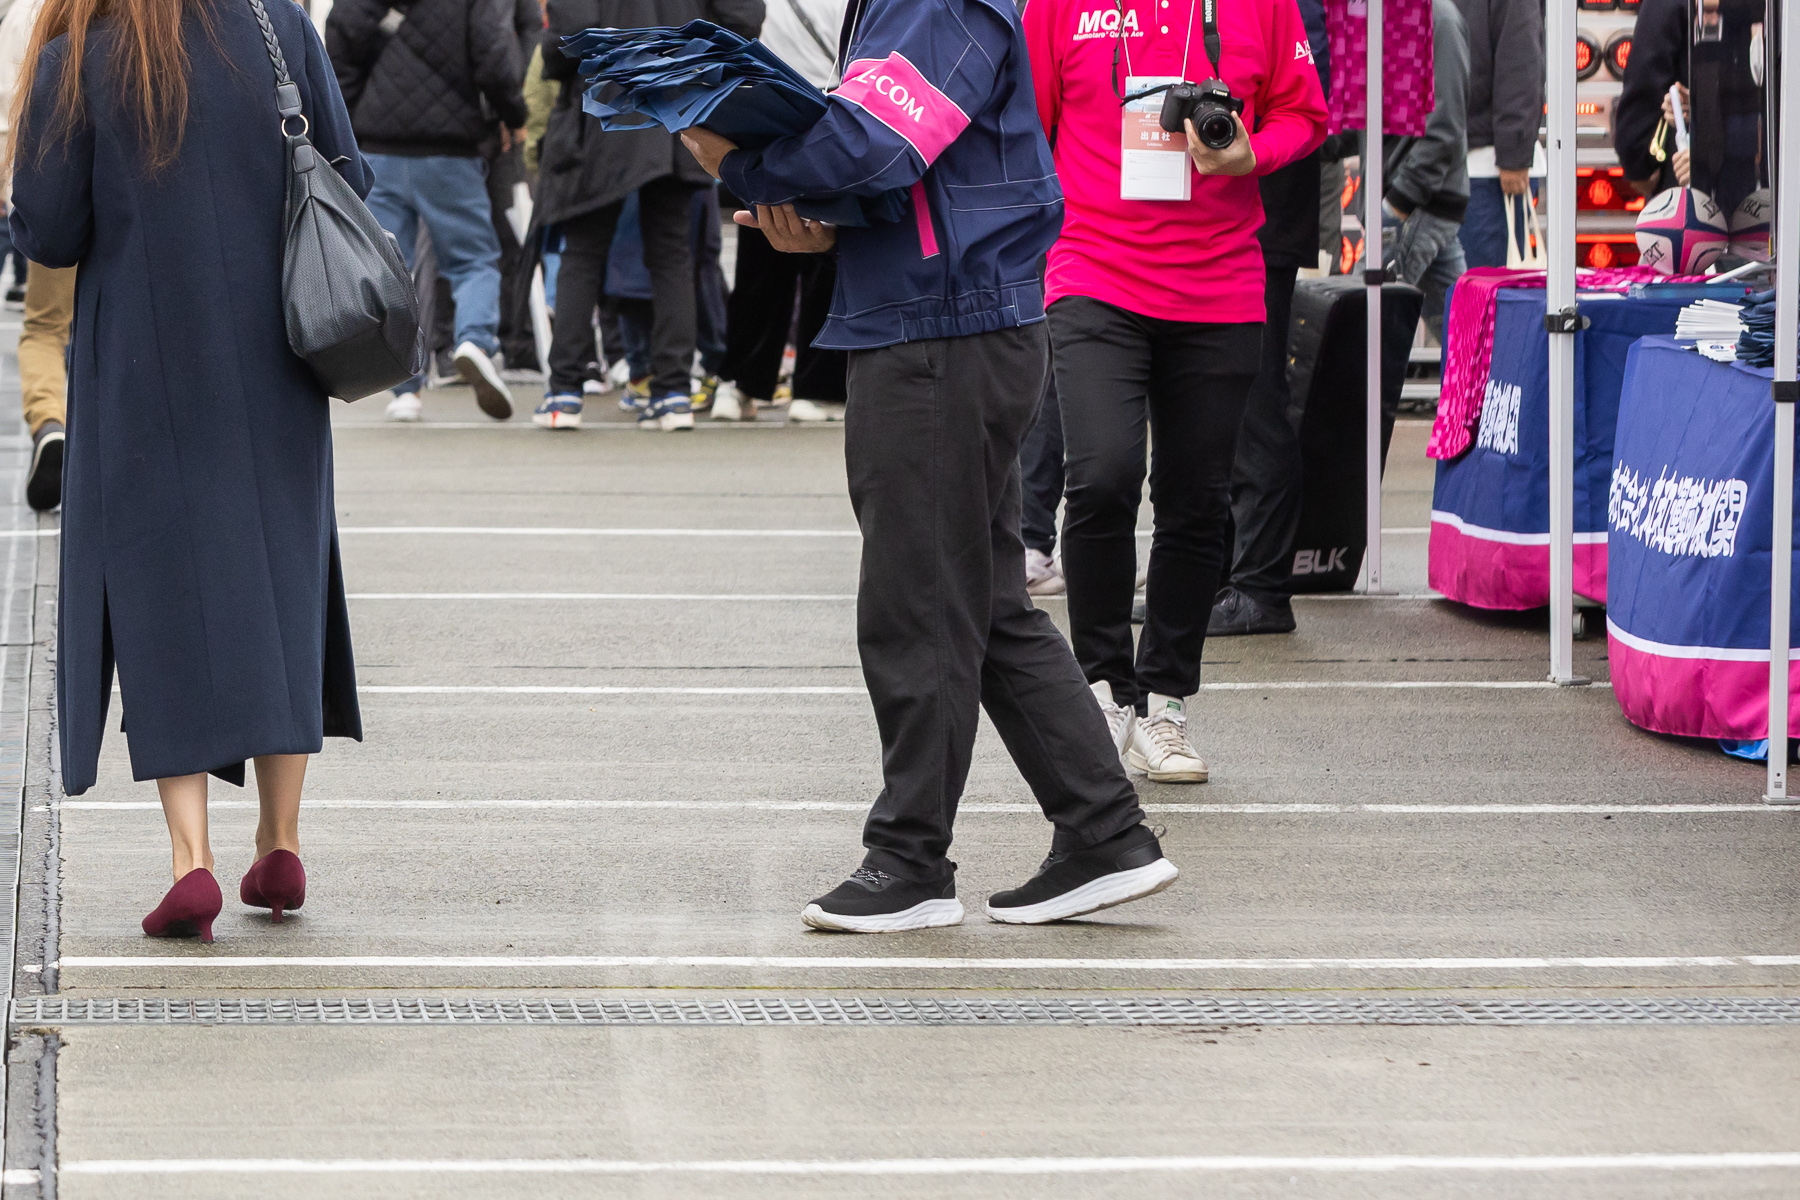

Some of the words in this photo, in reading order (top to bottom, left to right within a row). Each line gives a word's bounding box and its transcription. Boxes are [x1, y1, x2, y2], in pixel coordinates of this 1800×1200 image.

[1077, 8, 1139, 35] MQA
[1109, 30, 1129, 38] Quck
[1130, 30, 1144, 38] Ace
[852, 67, 925, 123] Z-COM
[1291, 546, 1350, 576] BLK
